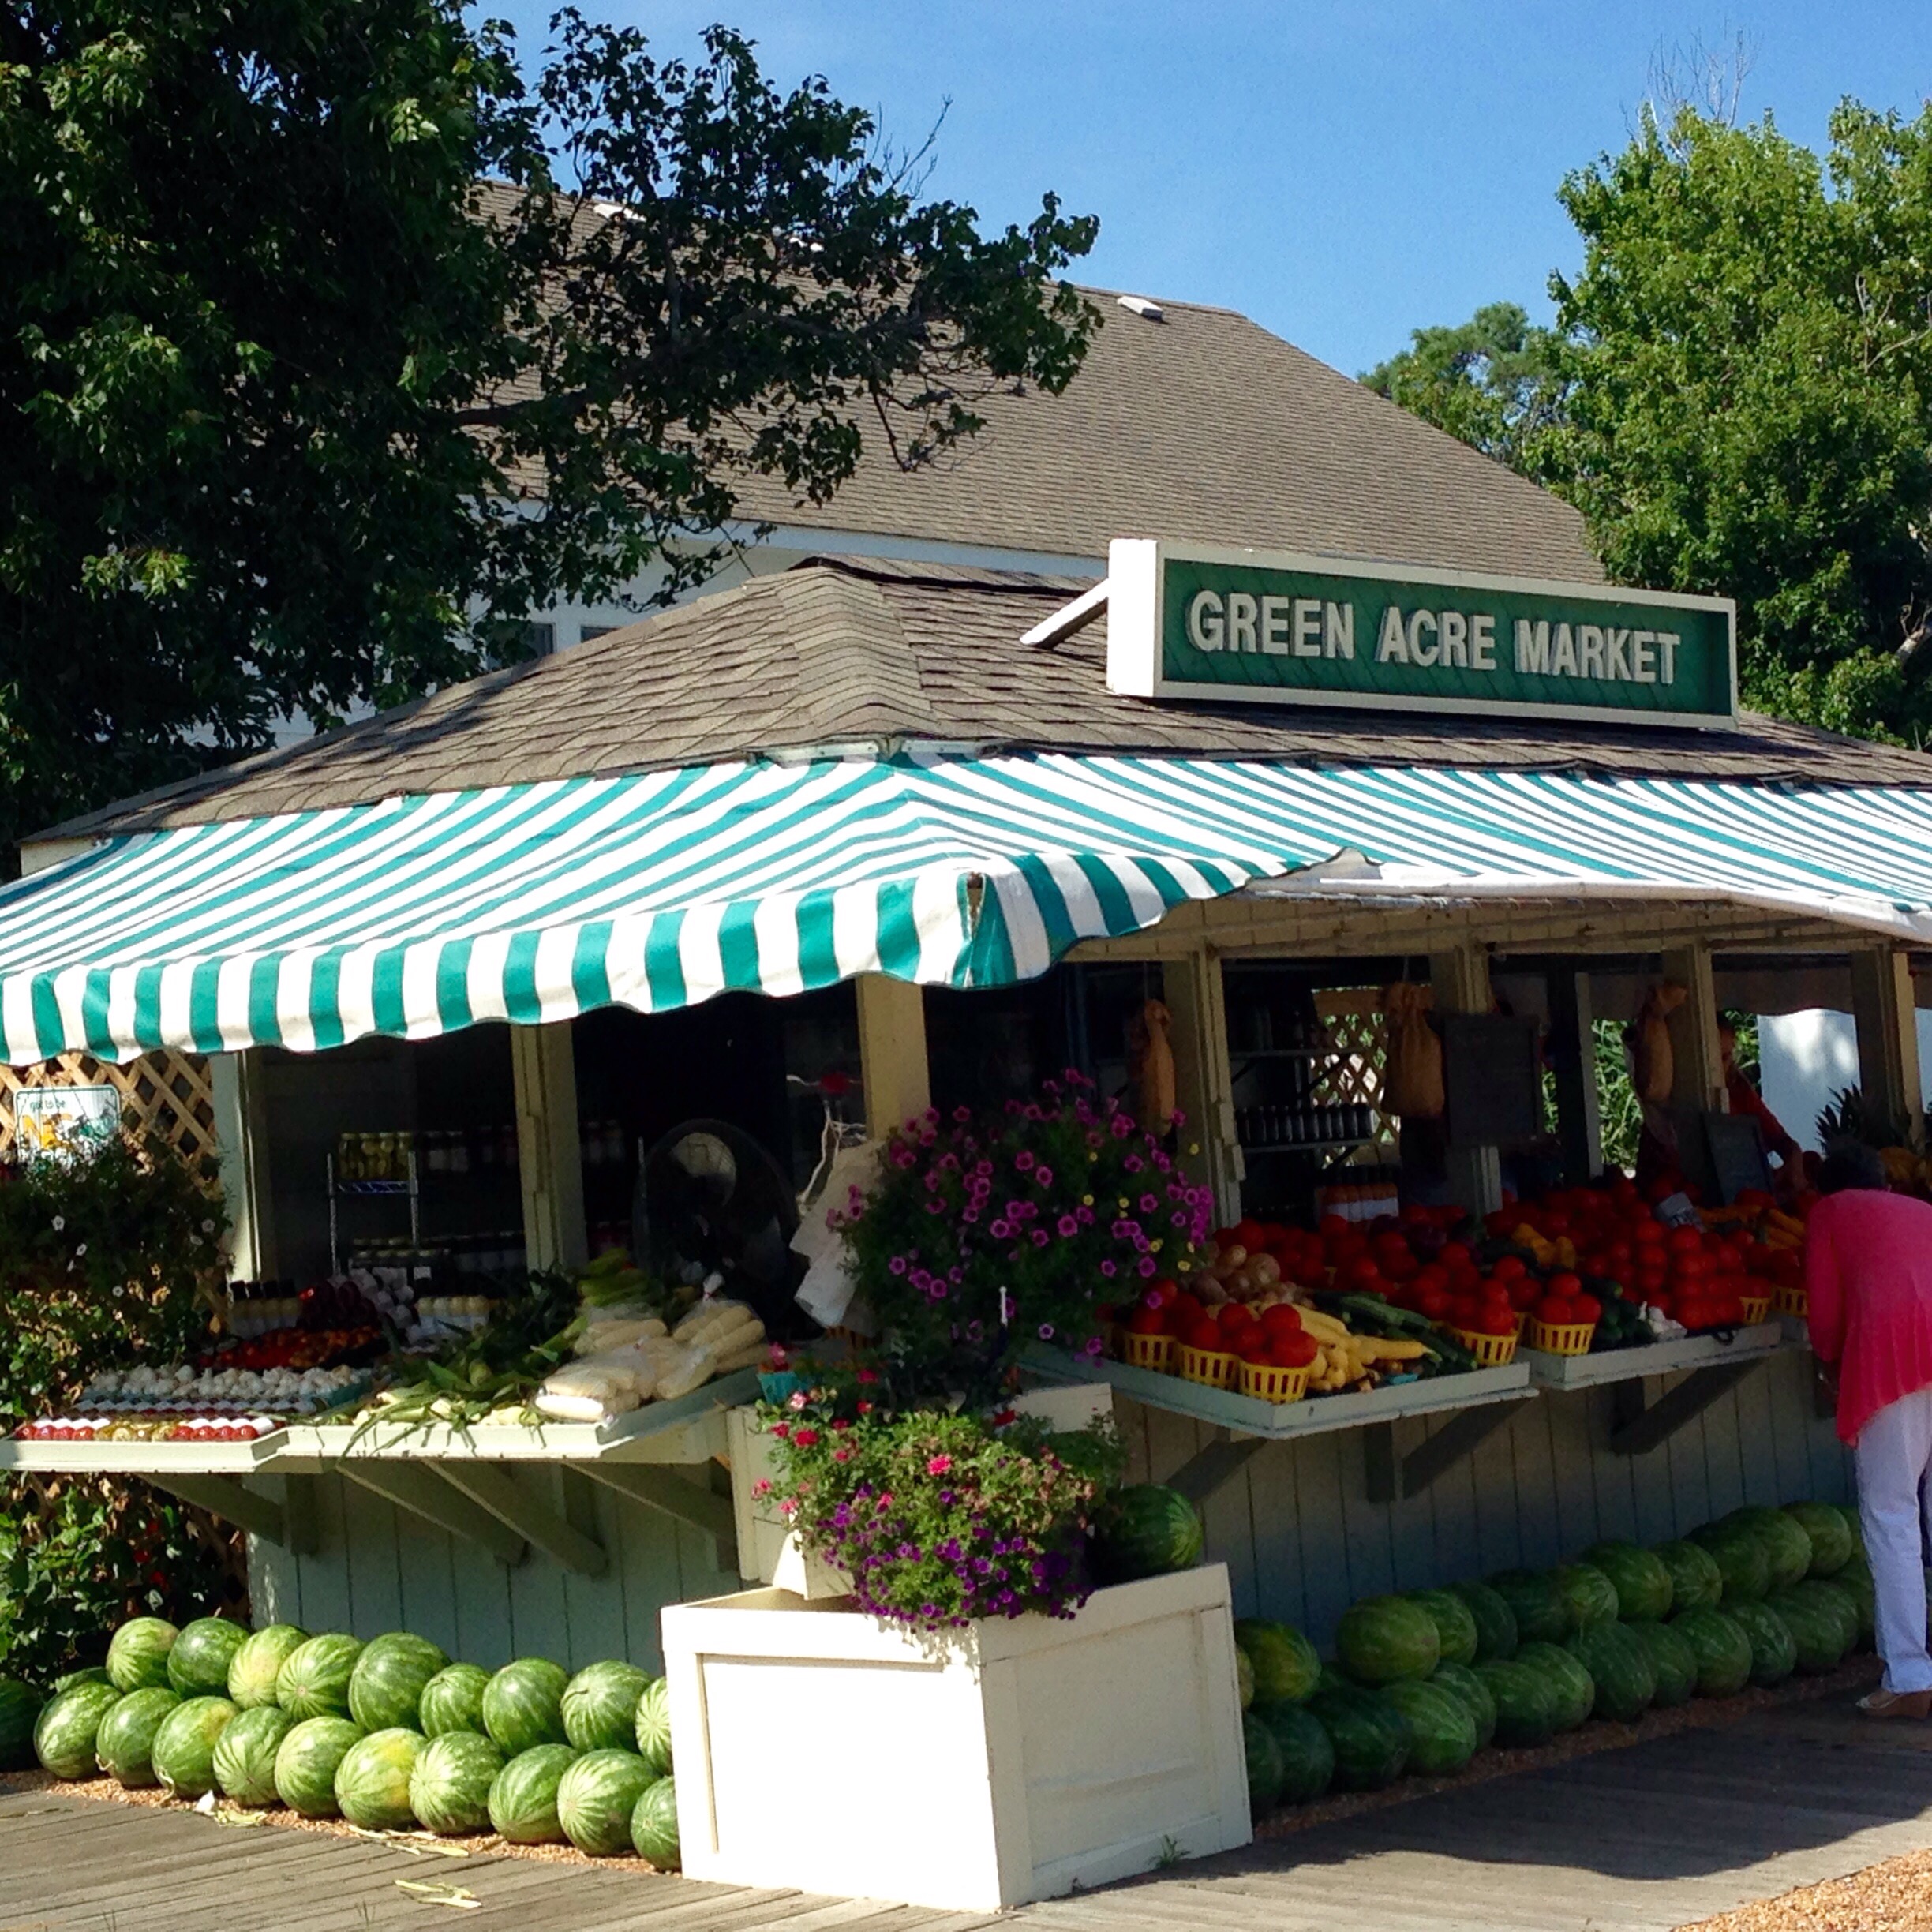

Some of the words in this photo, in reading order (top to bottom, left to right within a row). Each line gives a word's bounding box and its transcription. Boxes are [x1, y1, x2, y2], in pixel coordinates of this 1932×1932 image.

[1185, 590, 1355, 660] GREEN
[1374, 606, 1497, 671] ACRE
[1514, 619, 1681, 685] MARKET
[45, 1100, 54, 1109] to
